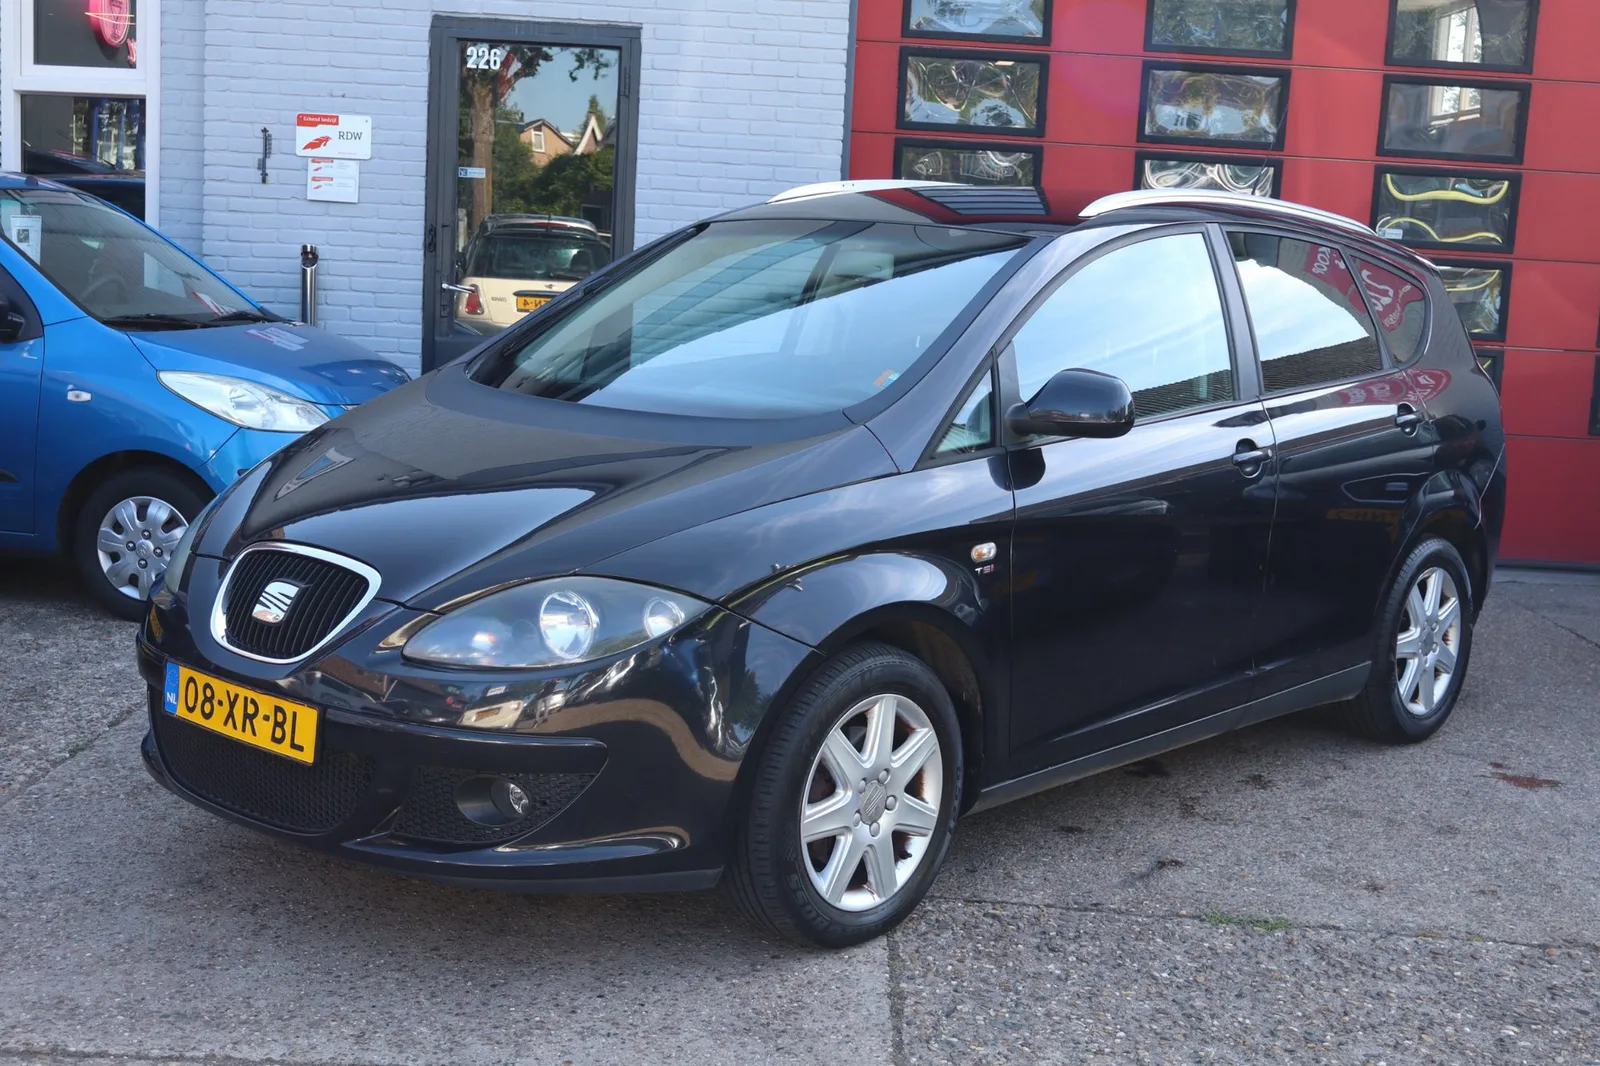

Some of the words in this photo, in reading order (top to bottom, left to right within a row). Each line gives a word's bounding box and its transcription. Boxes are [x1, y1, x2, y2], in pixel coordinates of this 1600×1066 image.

[466, 46, 501, 70] 226
[338, 131, 363, 140] RDW
[166, 692, 177, 705] NL
[184, 676, 305, 752] 08-XR-BL
